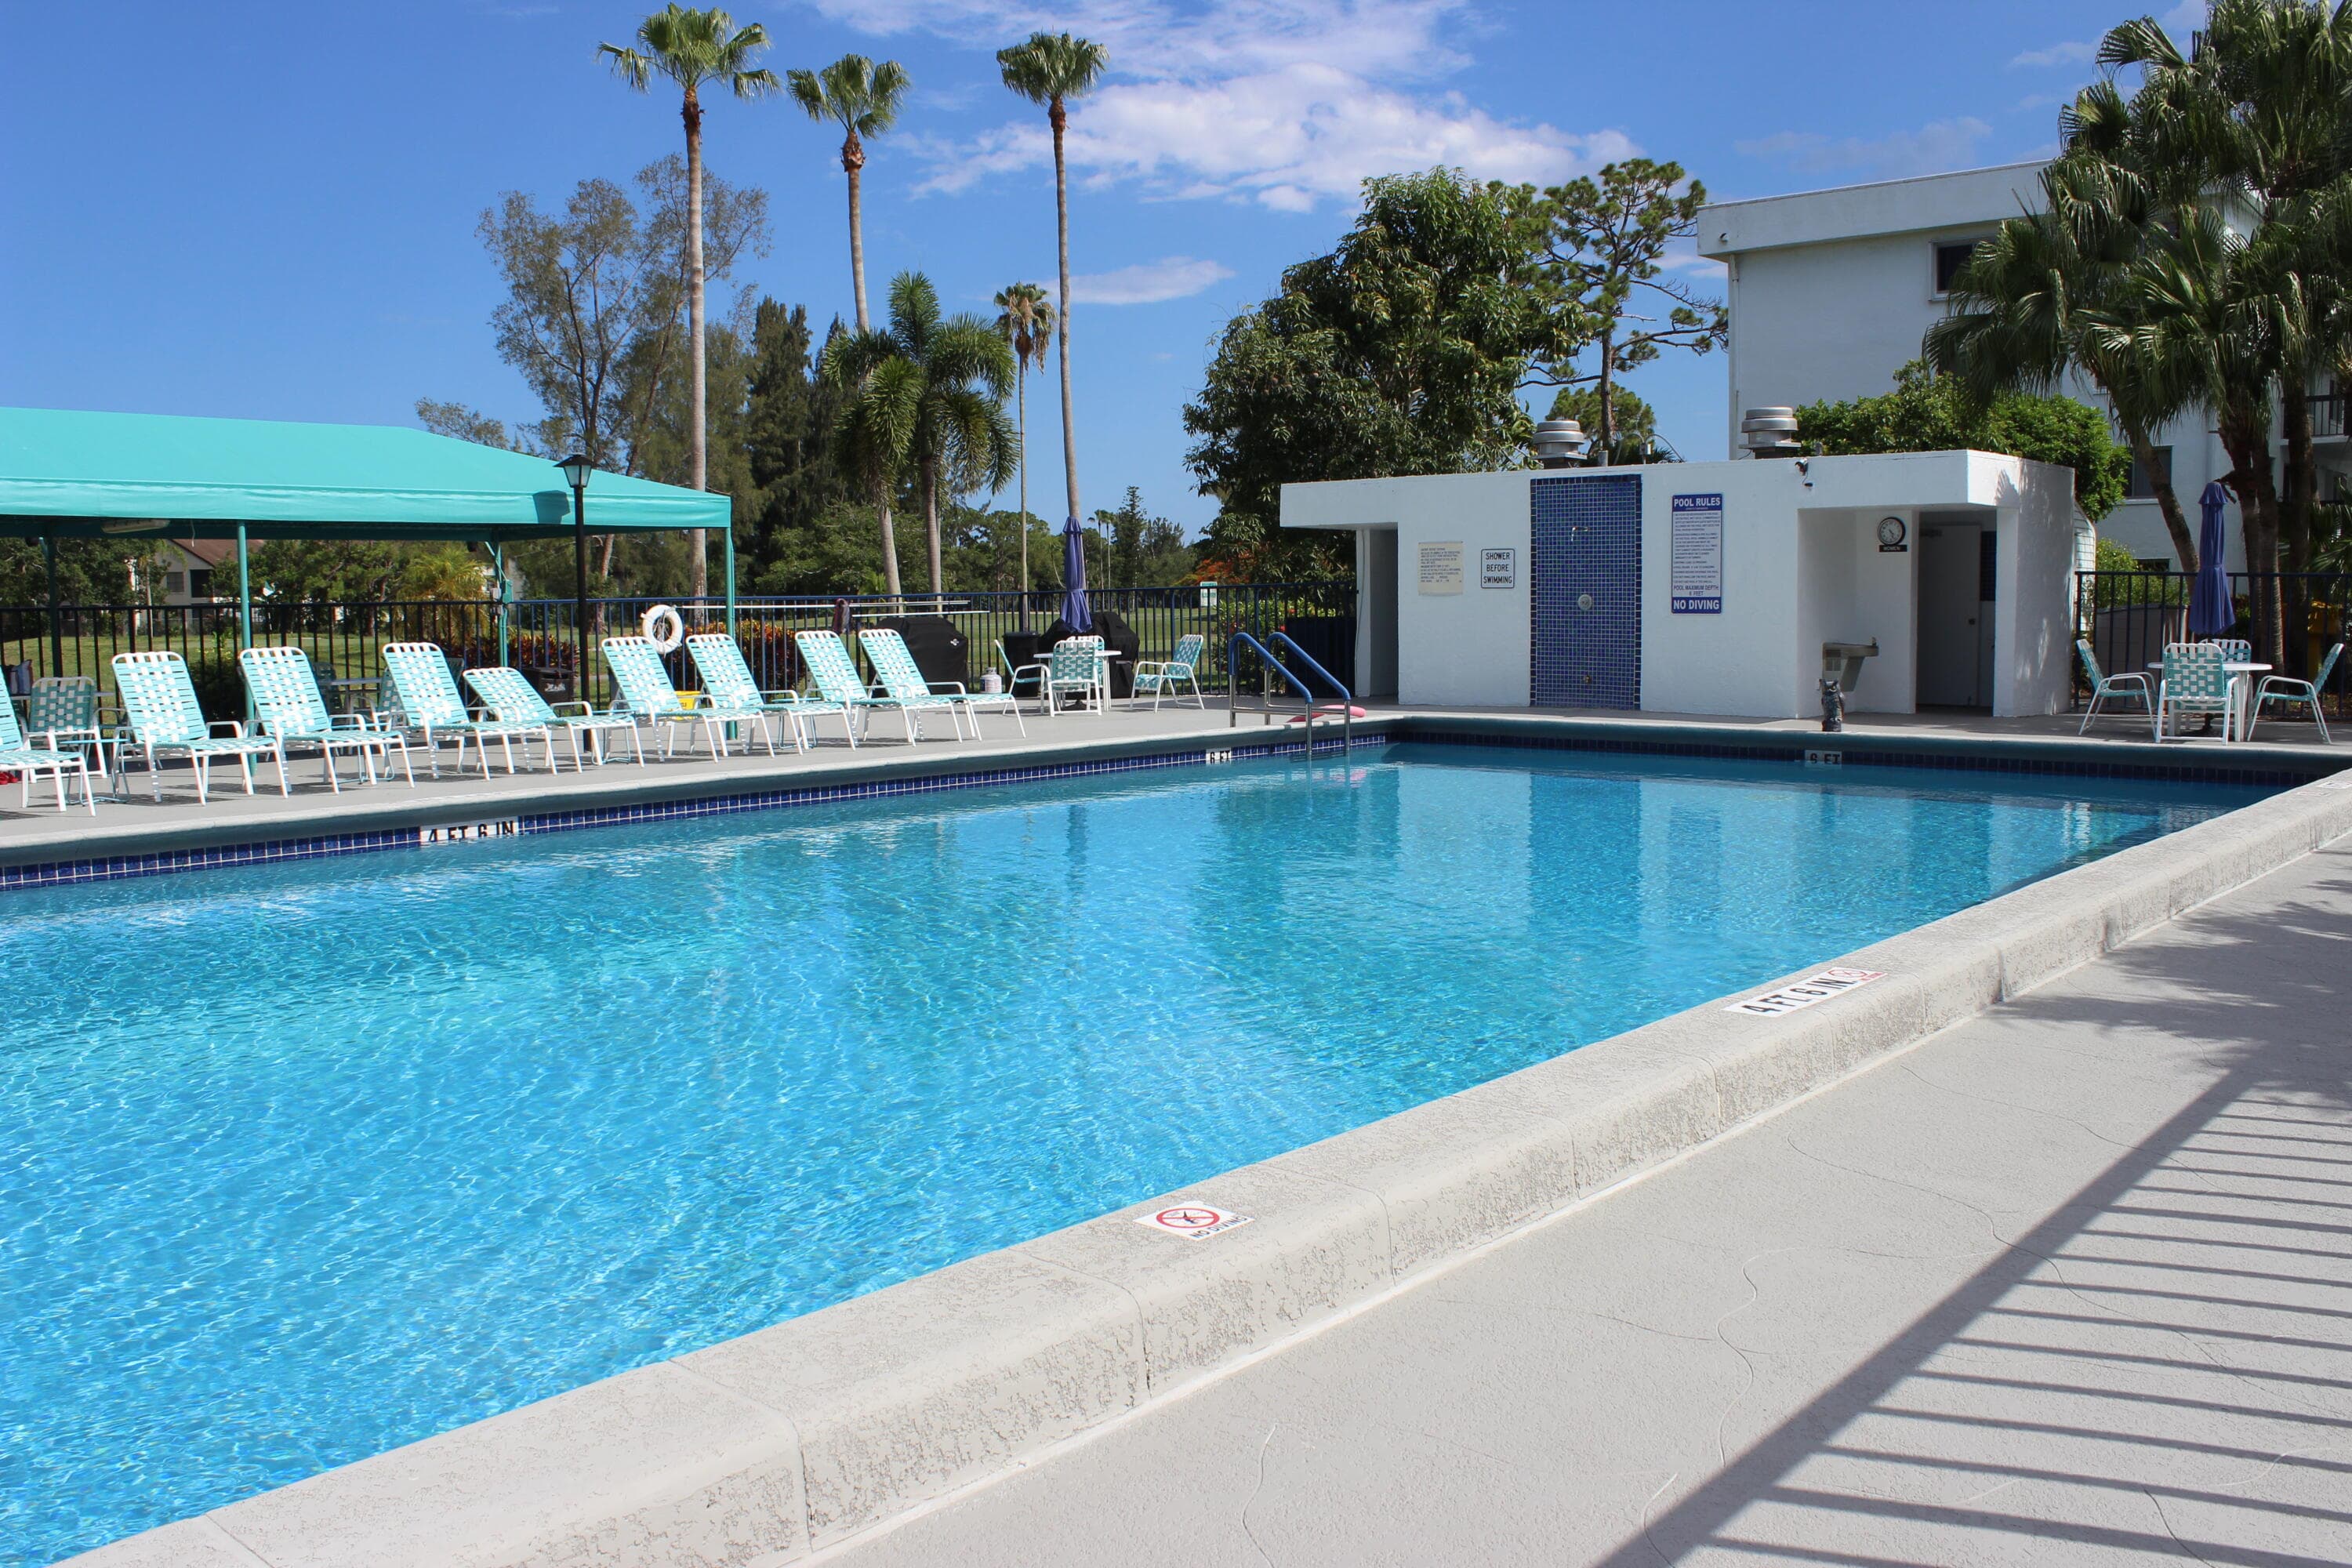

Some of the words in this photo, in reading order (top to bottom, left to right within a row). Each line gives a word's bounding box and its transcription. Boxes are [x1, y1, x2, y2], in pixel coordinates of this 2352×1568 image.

[1674, 499, 1694, 507] POOL
[1696, 497, 1721, 506] RULES
[1486, 552, 1511, 561] SHOWER
[1486, 564, 1509, 572] BEFORE
[1483, 575, 1512, 584] SWIMMING
[1673, 600, 1686, 610] NO
[1688, 599, 1719, 610] DIVING
[448, 826, 469, 840] FT
[477, 823, 488, 837] 6
[495, 820, 514, 835] IN
[1189, 1229, 1210, 1239] NO
[1207, 1215, 1247, 1232] DIVING
